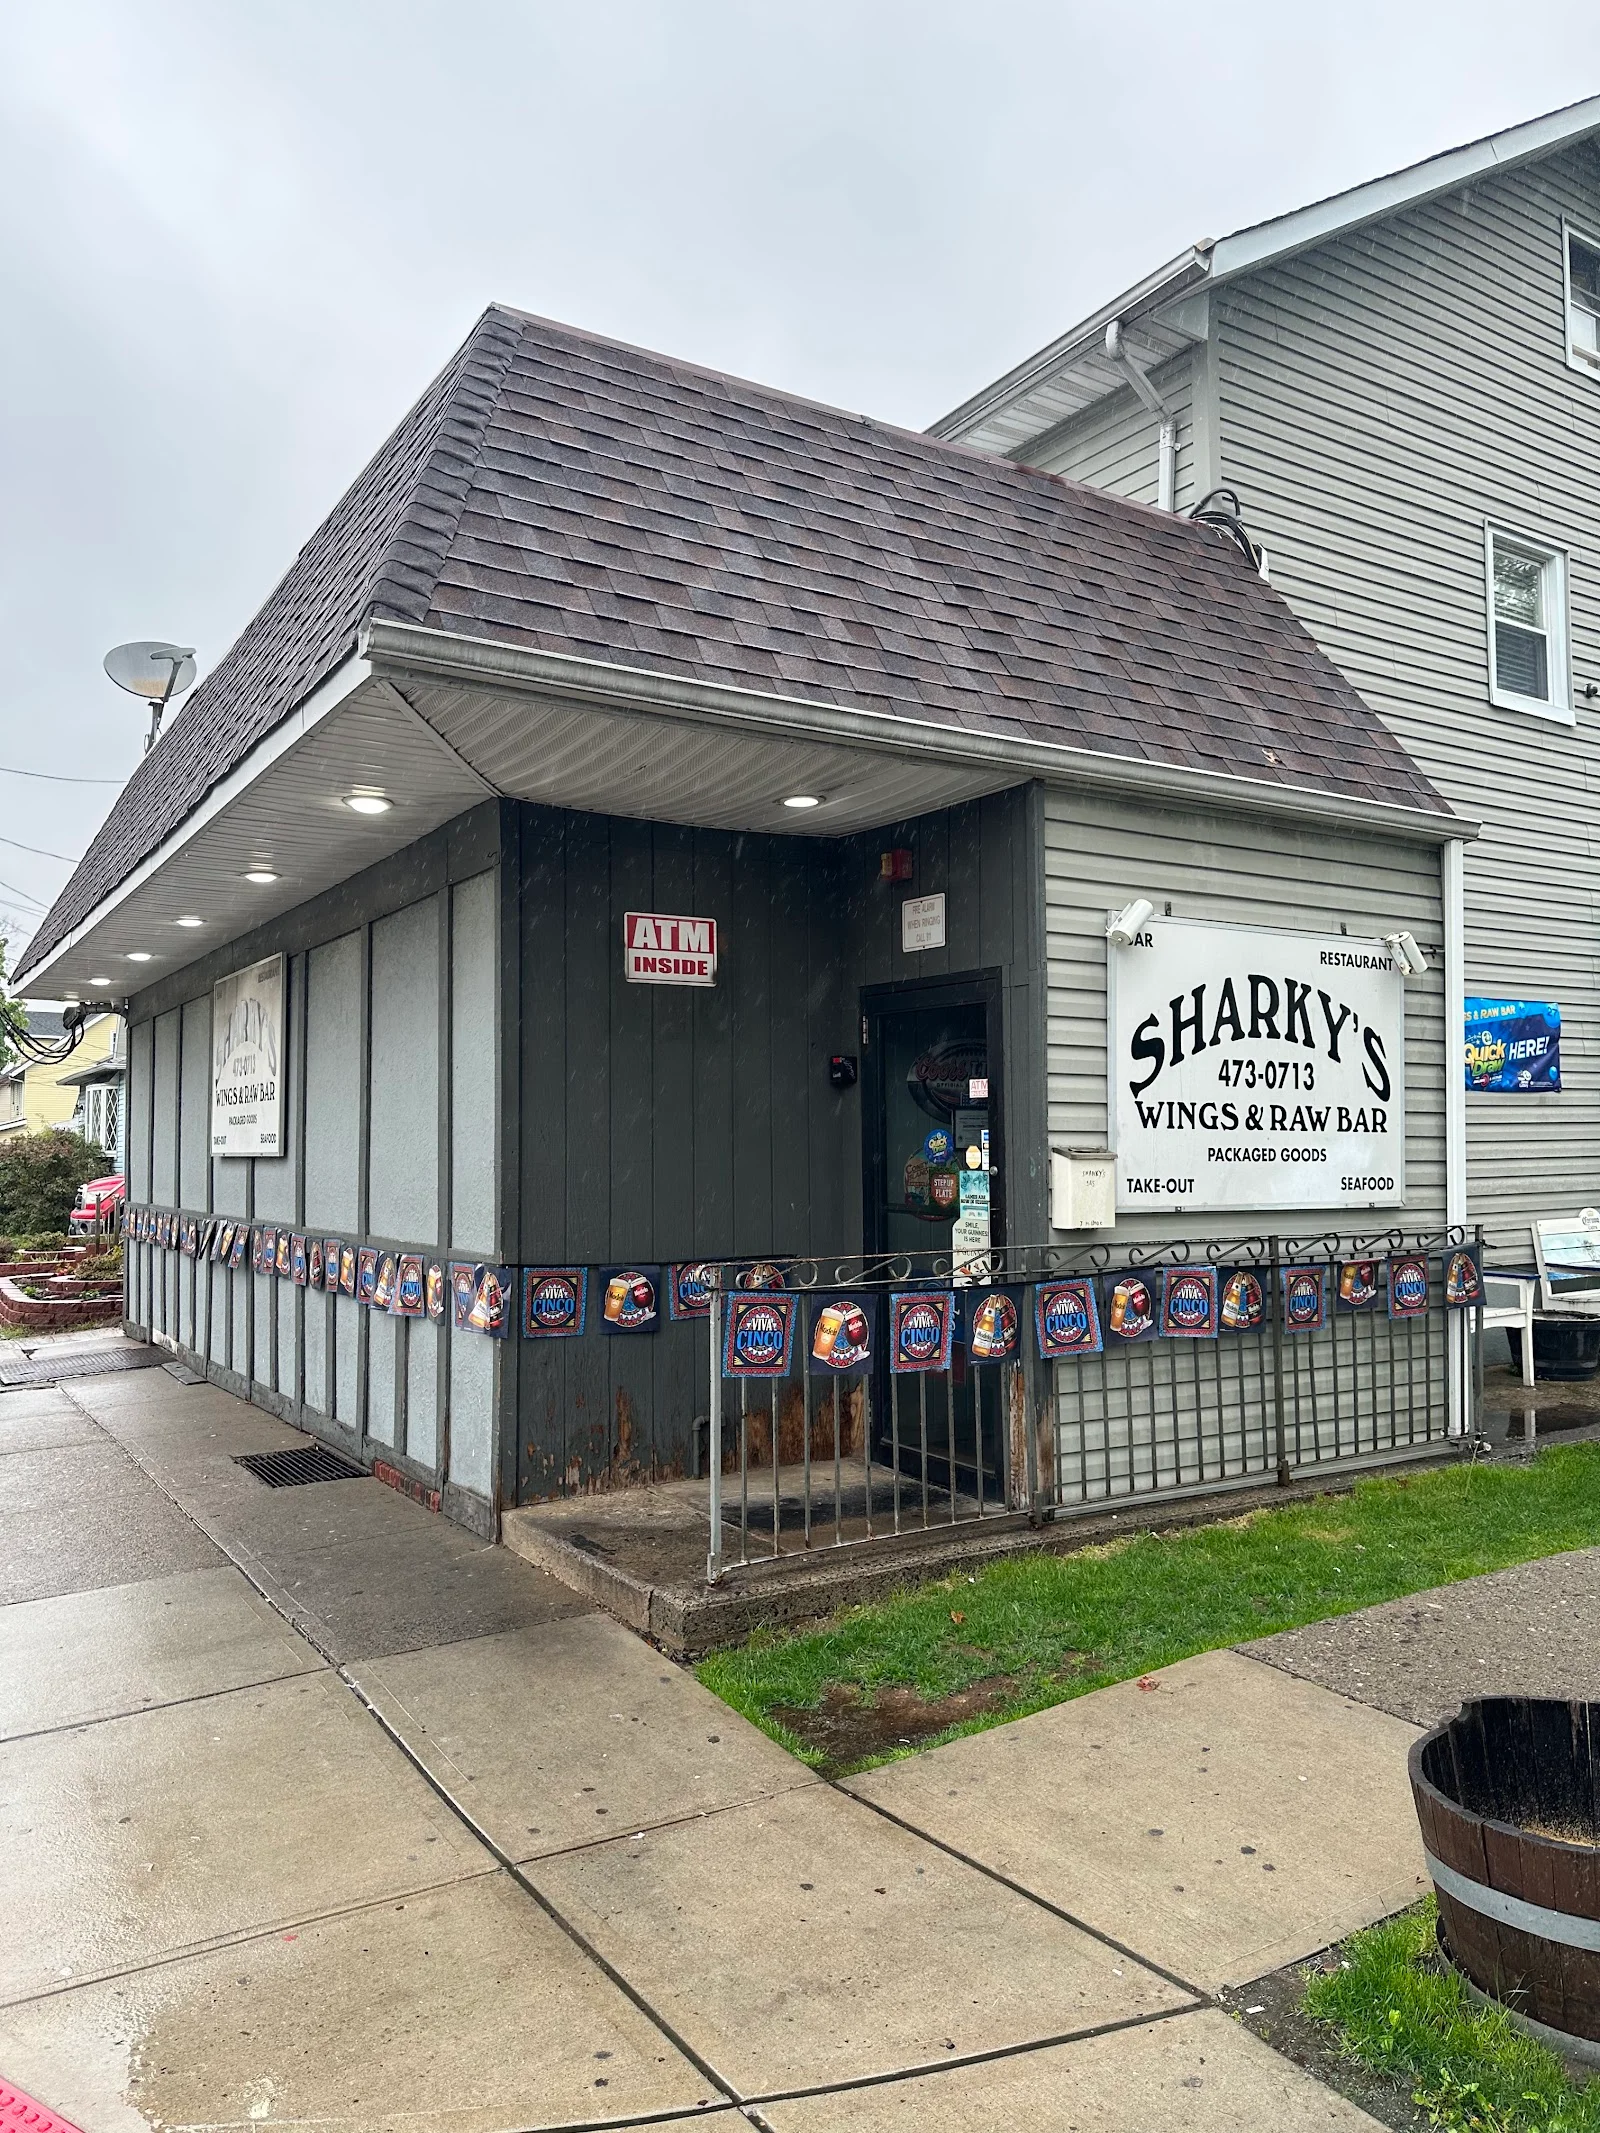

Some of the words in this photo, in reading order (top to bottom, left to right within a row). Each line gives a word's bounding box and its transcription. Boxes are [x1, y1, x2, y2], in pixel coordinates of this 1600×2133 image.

[633, 918, 710, 952] ATM
[1128, 932, 1154, 948] AR
[634, 956, 708, 975] INSIDE
[1320, 951, 1393, 972] RESTAURANT
[1480, 1007, 1499, 1019] RAW
[1500, 1004, 1516, 1016] BAR
[1129, 974, 1391, 1102] SHARKY'S
[1508, 1036, 1550, 1060] HERE!
[1218, 1059, 1315, 1091] 473-0713
[216, 1087, 238, 1107] WINGS
[239, 1086, 243, 1104] &
[244, 1083, 259, 1104] RAW
[259, 1081, 275, 1101] BAR
[971, 1080, 988, 1091] ATM
[1134, 1100, 1239, 1131] WINGS
[1245, 1104, 1264, 1131] &
[1269, 1105, 1331, 1132] RAW
[1336, 1106, 1388, 1133] BAR
[1207, 1147, 1276, 1162] PACKAGED
[1280, 1148, 1327, 1162] GOODS
[1126, 1178, 1195, 1193] TAKE-OUT
[1340, 1176, 1394, 1191] SEAFOOD
[935, 1189, 953, 1199] PLATE
[680, 1281, 706, 1298] CIN
[1180, 1288, 1198, 1299] VIVA
[1395, 1281, 1426, 1298] CINCO
[533, 1298, 575, 1315] CINCO
[1170, 1298, 1208, 1315] CINCO
[1290, 1296, 1317, 1312] CINCO
[751, 1317, 773, 1331] VIVA
[1046, 1312, 1087, 1333] CINCO
[737, 1330, 783, 1350] CINCO
[901, 1327, 940, 1347] CINCO
